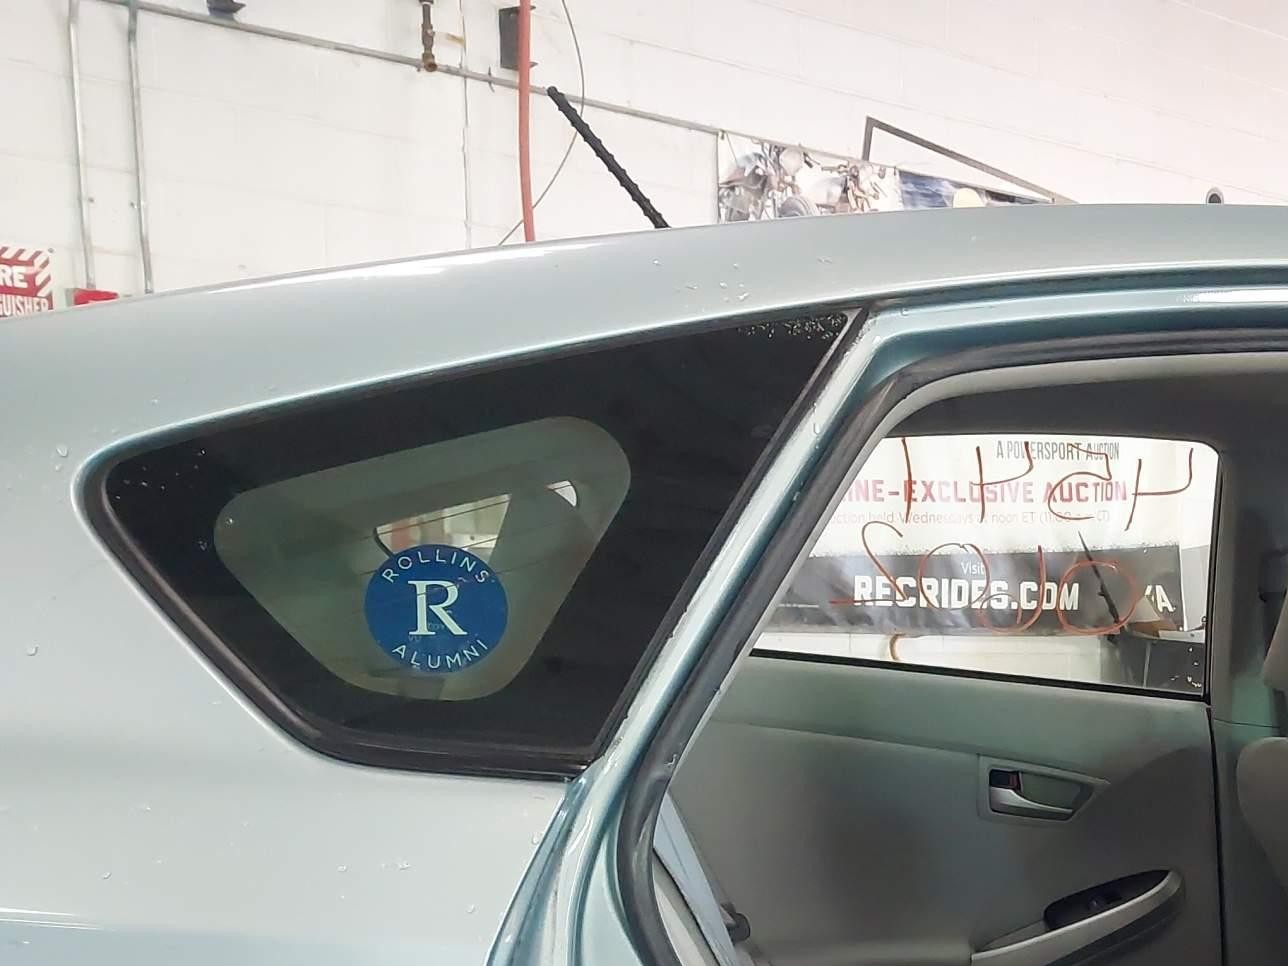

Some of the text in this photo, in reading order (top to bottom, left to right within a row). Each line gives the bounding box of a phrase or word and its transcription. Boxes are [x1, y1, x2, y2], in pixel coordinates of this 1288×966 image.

[996, 440, 1120, 461] A POWERSPORT AUCTION
[842, 479, 1128, 504] INE-EXCLUSIVE AUCTION
[382, 548, 490, 584] ROLLINS
[960, 561, 985, 576] Visit
[407, 580, 468, 636] R
[853, 575, 1080, 611] RECRIDES.COM
[391, 639, 489, 669] ALUMNI
